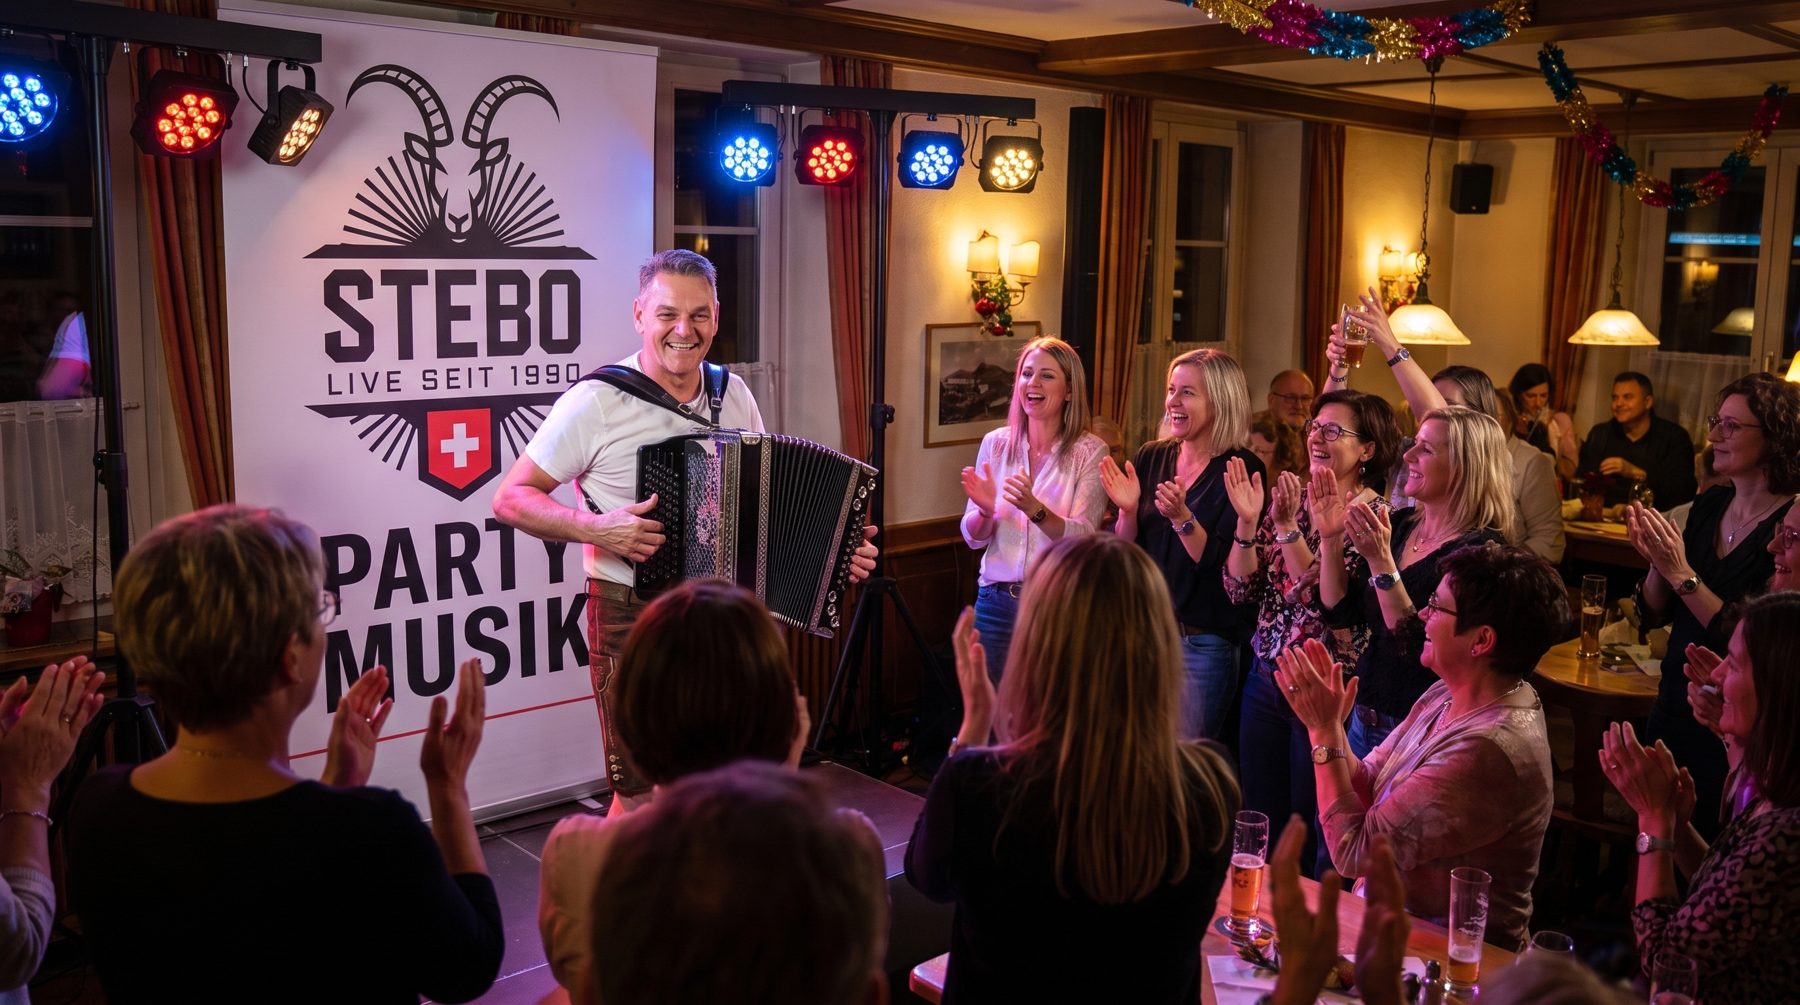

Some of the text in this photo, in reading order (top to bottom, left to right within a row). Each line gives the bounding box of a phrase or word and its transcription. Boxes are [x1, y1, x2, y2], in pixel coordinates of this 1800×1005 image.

[323, 269, 582, 363] STEBO
[327, 362, 581, 396] LIVE SEIT 1990
[320, 517, 569, 616] PARTY
[325, 592, 590, 714] MUSIK
